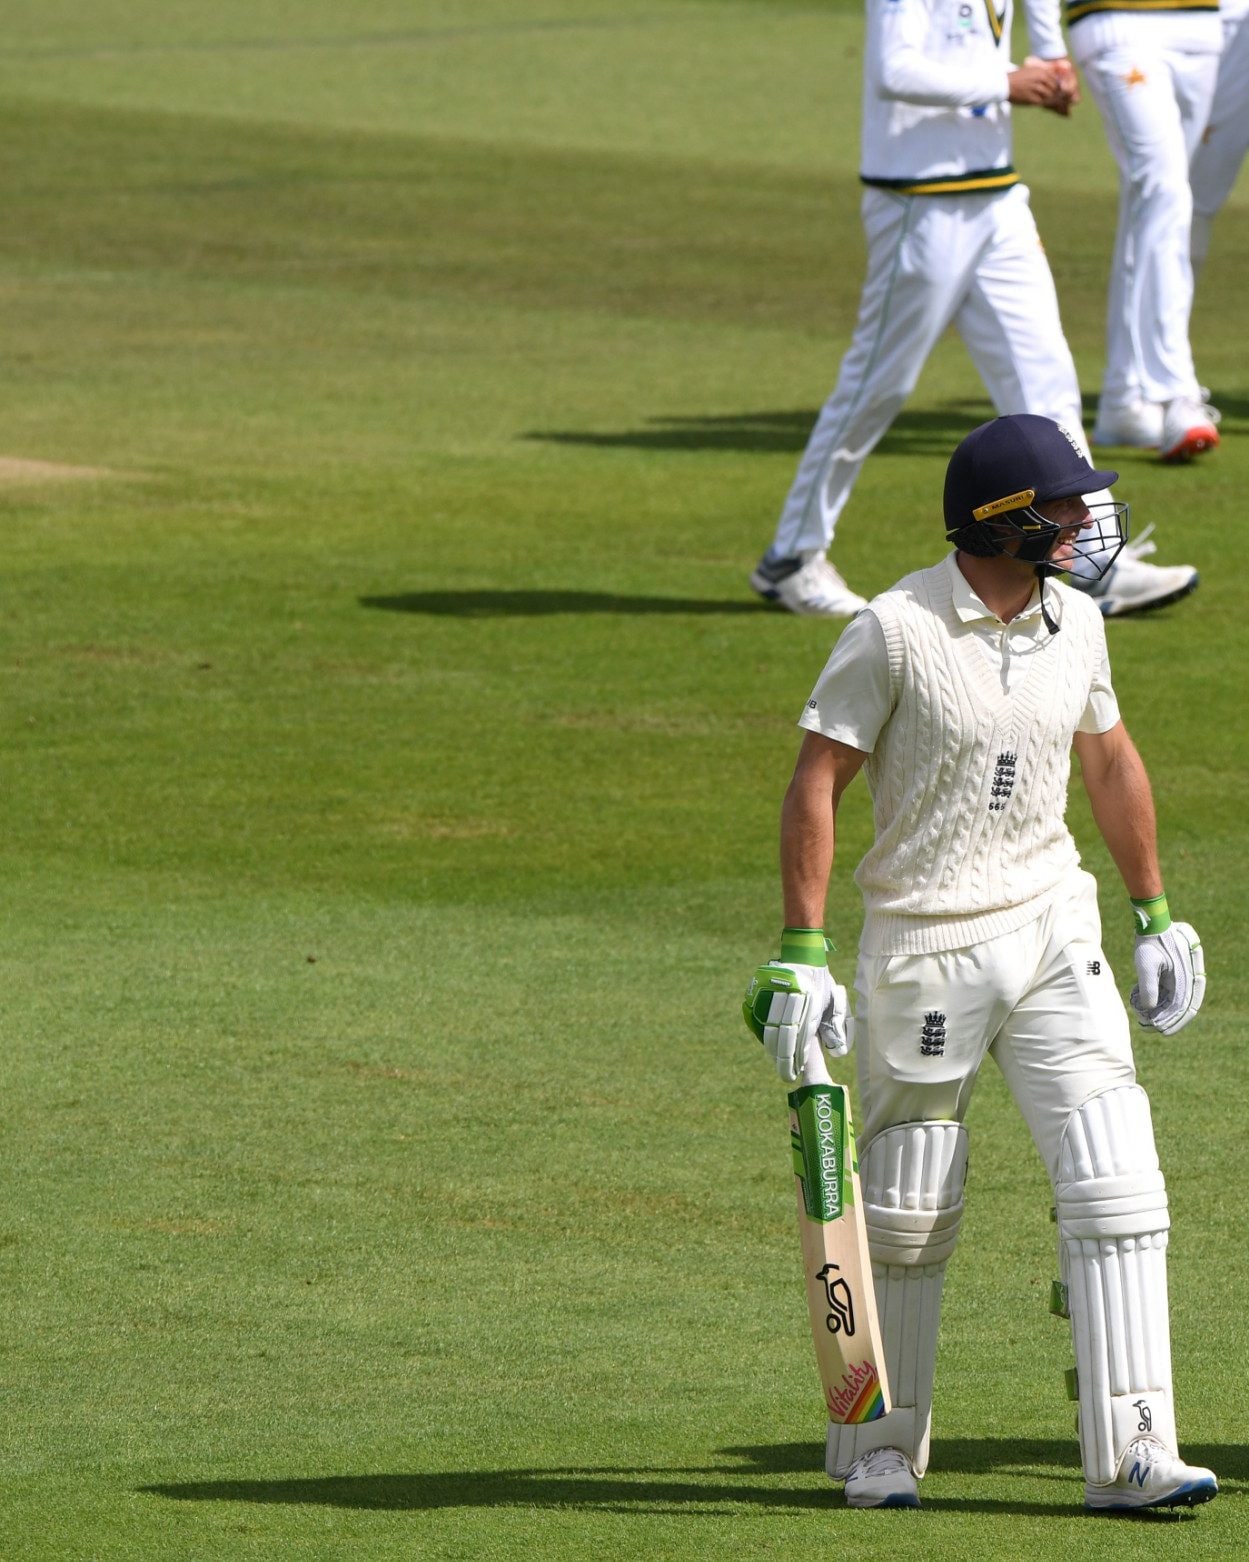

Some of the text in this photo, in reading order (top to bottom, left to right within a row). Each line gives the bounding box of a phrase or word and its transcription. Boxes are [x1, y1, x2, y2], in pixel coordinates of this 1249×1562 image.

[991, 495, 1025, 510] MASURI
[815, 1093, 840, 1216] KOOKABURRA
[827, 1360, 878, 1417] Vitality
